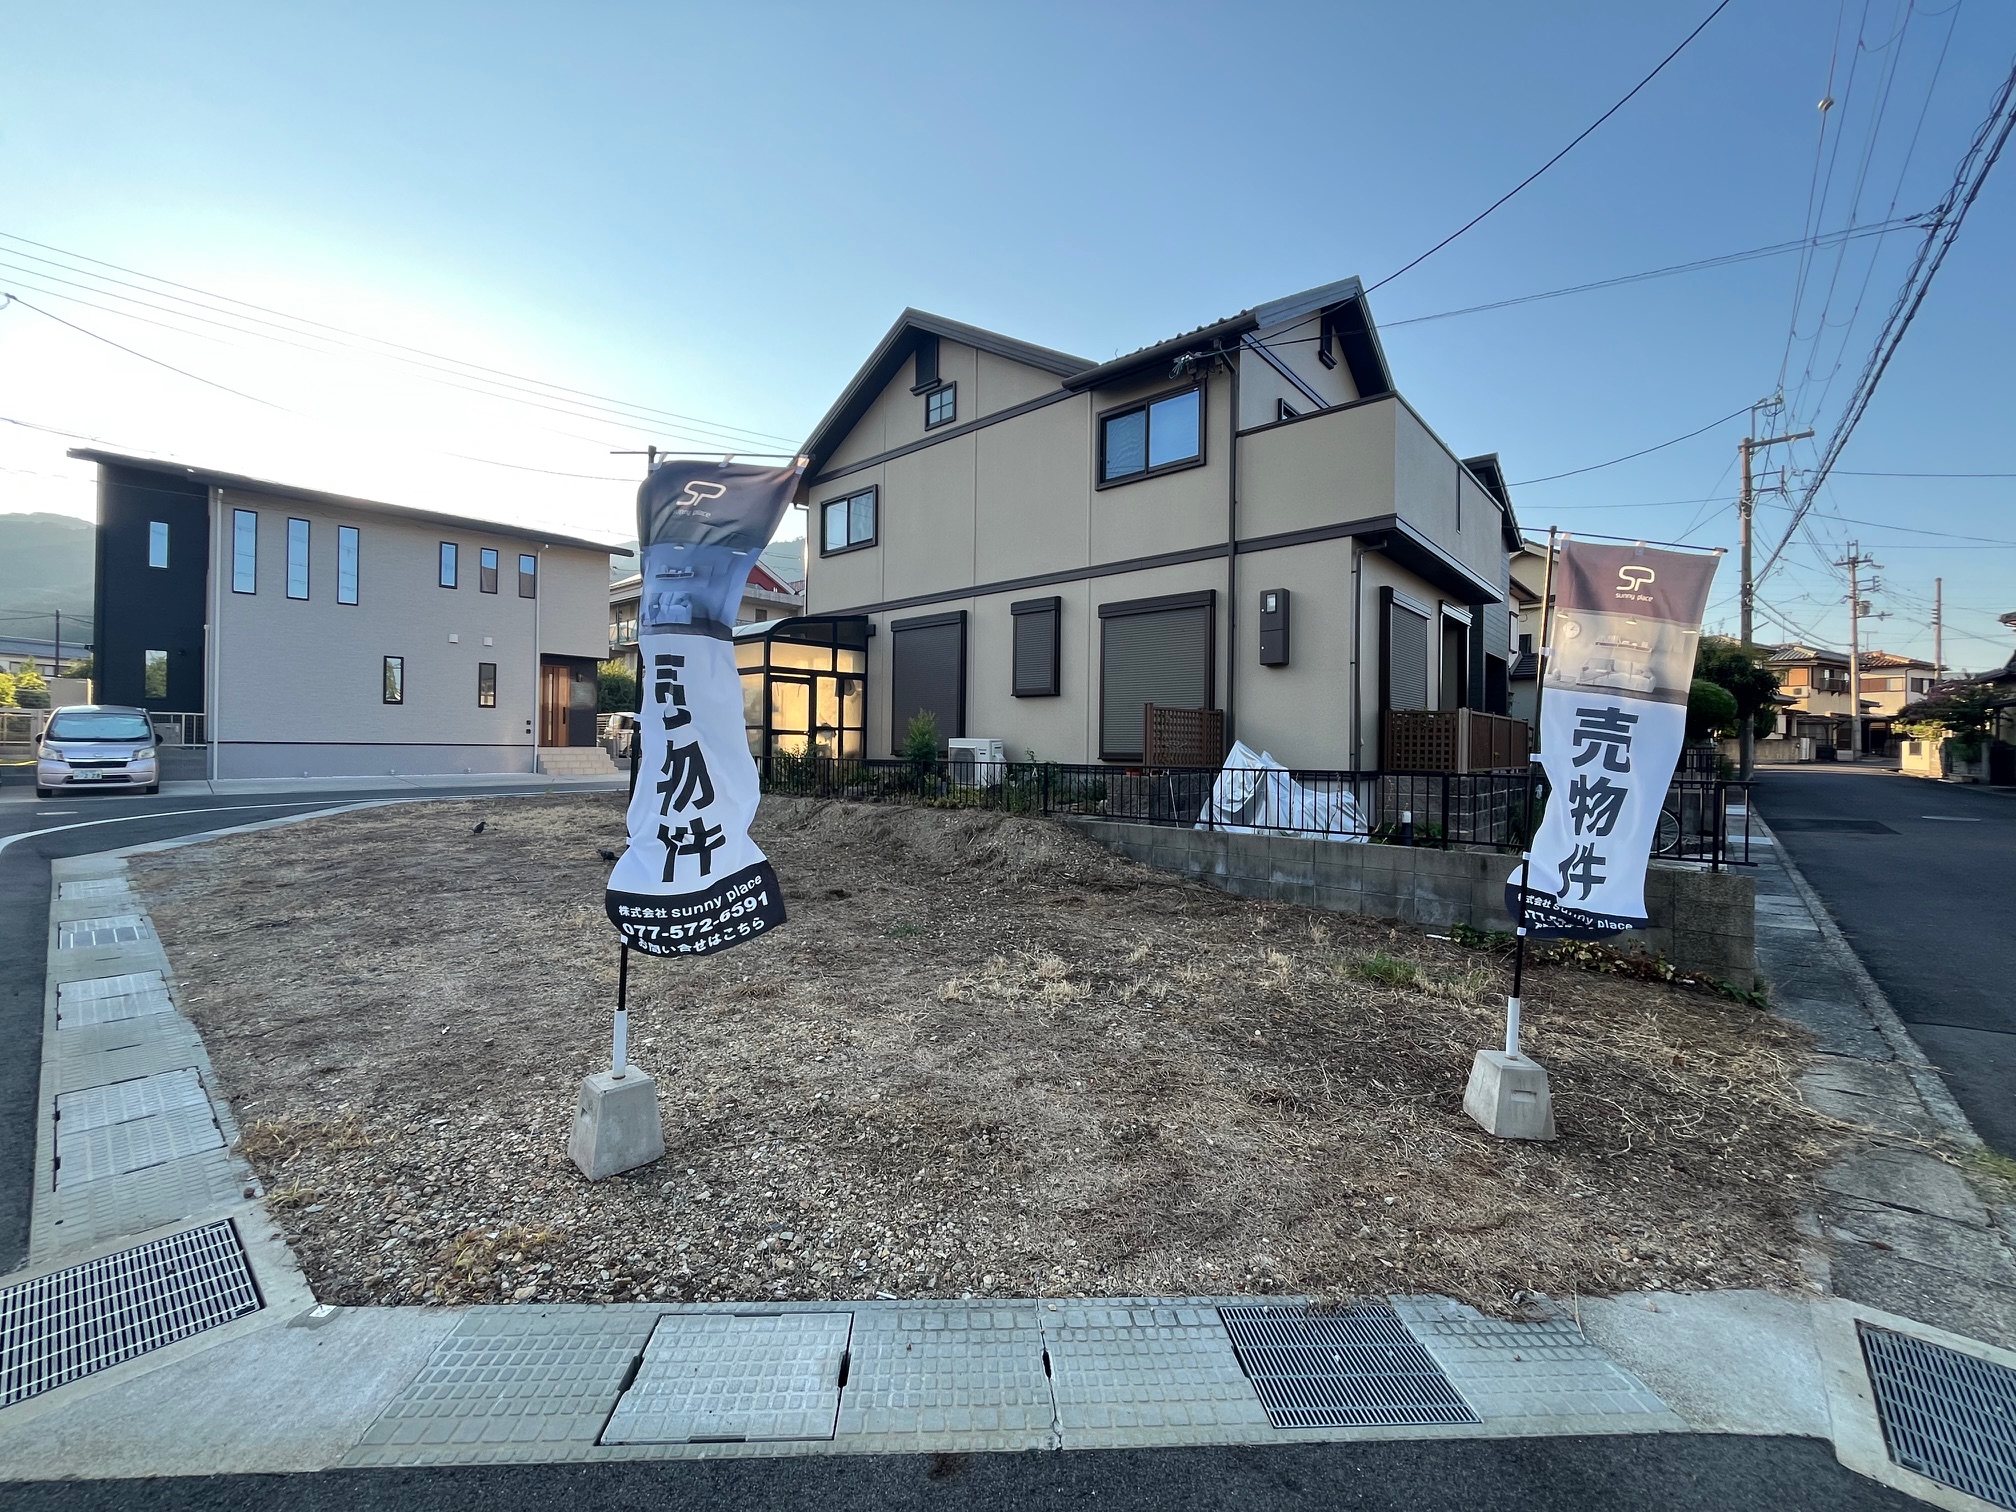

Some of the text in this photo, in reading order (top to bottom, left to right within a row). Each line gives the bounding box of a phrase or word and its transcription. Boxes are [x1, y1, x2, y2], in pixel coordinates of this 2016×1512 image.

[676, 480, 727, 506] SP
[1615, 565, 1655, 591] SP
[1615, 592, 1654, 602] sunny place
[1557, 706, 1640, 901] 売物件
[618, 875, 762, 919] 株式会社 sunny place
[622, 890, 769, 940] 077-572-6591
[638, 916, 765, 954] お問い合せはこちら
